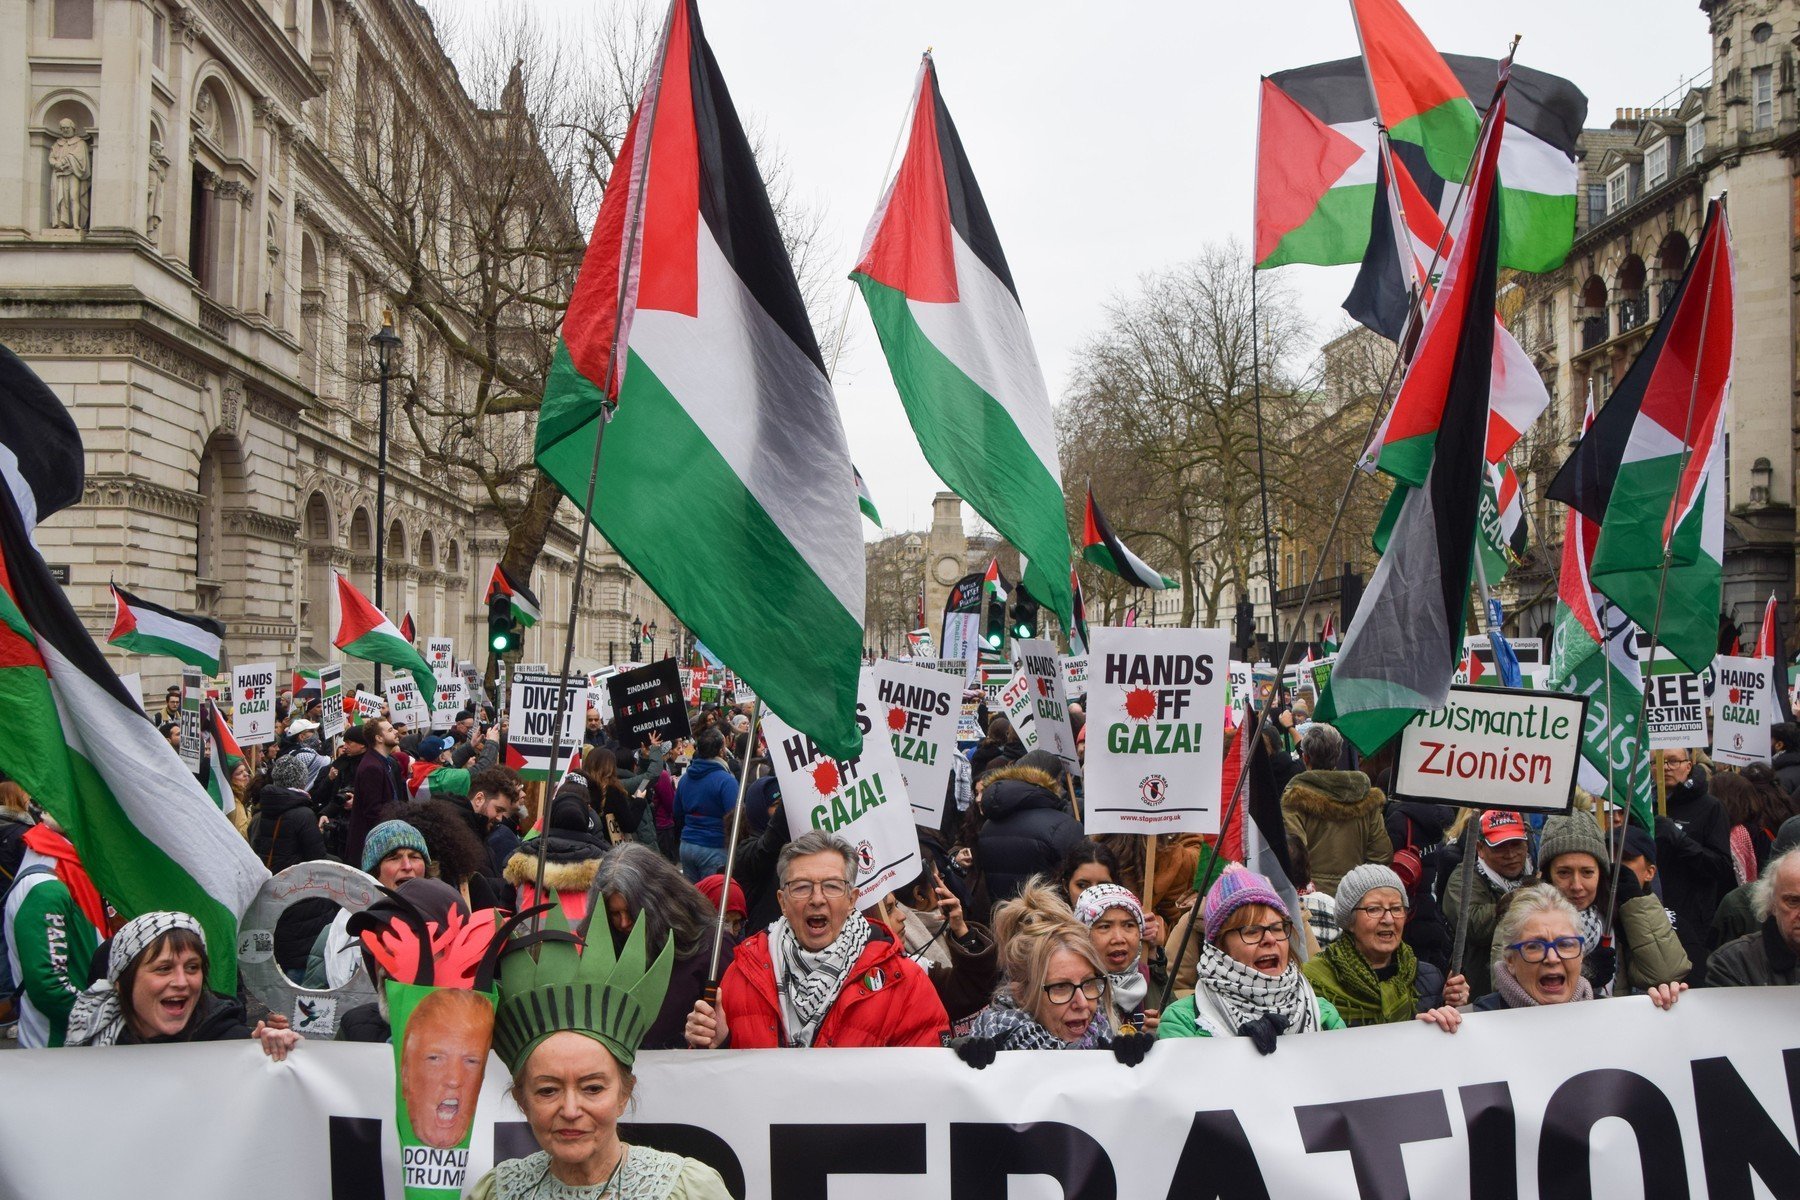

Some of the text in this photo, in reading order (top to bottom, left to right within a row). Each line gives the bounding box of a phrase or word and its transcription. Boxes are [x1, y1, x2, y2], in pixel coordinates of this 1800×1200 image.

[431, 643, 450, 652] HANDS
[915, 661, 936, 670] HAND
[1025, 655, 1057, 678] HANDS
[1065, 660, 1088, 670] HANDS
[1105, 653, 1214, 686] HANDS
[238, 673, 273, 688] HANDS
[390, 682, 413, 694] HAND
[437, 683, 462, 693] HANDS
[567, 678, 585, 686] AMPAIGN
[626, 678, 662, 695] ZINDABAAD
[1721, 669, 1765, 690] HANDS
[878, 678, 951, 716] HANDS
[1002, 676, 1028, 707] STO
[1642, 674, 1701, 708] REE
[240, 700, 270, 715] GAZA!
[323, 693, 342, 717] FREE
[357, 696, 382, 710] HANDS
[394, 701, 412, 712] GAZ
[437, 701, 460, 710] GAZA!
[1011, 691, 1031, 718] ARM
[1037, 699, 1064, 723] GAZA!
[1645, 706, 1702, 723] ESTINE
[1722, 705, 1760, 726] GAZA!
[632, 716, 672, 733] CHARDI KALA
[1660, 722, 1702, 732] OCCUPATION
[782, 702, 873, 773] HAS
[1107, 722, 1202, 755] GAZA!
[1417, 740, 1552, 785] Zionism
[810, 772, 887, 834] GAZA!
